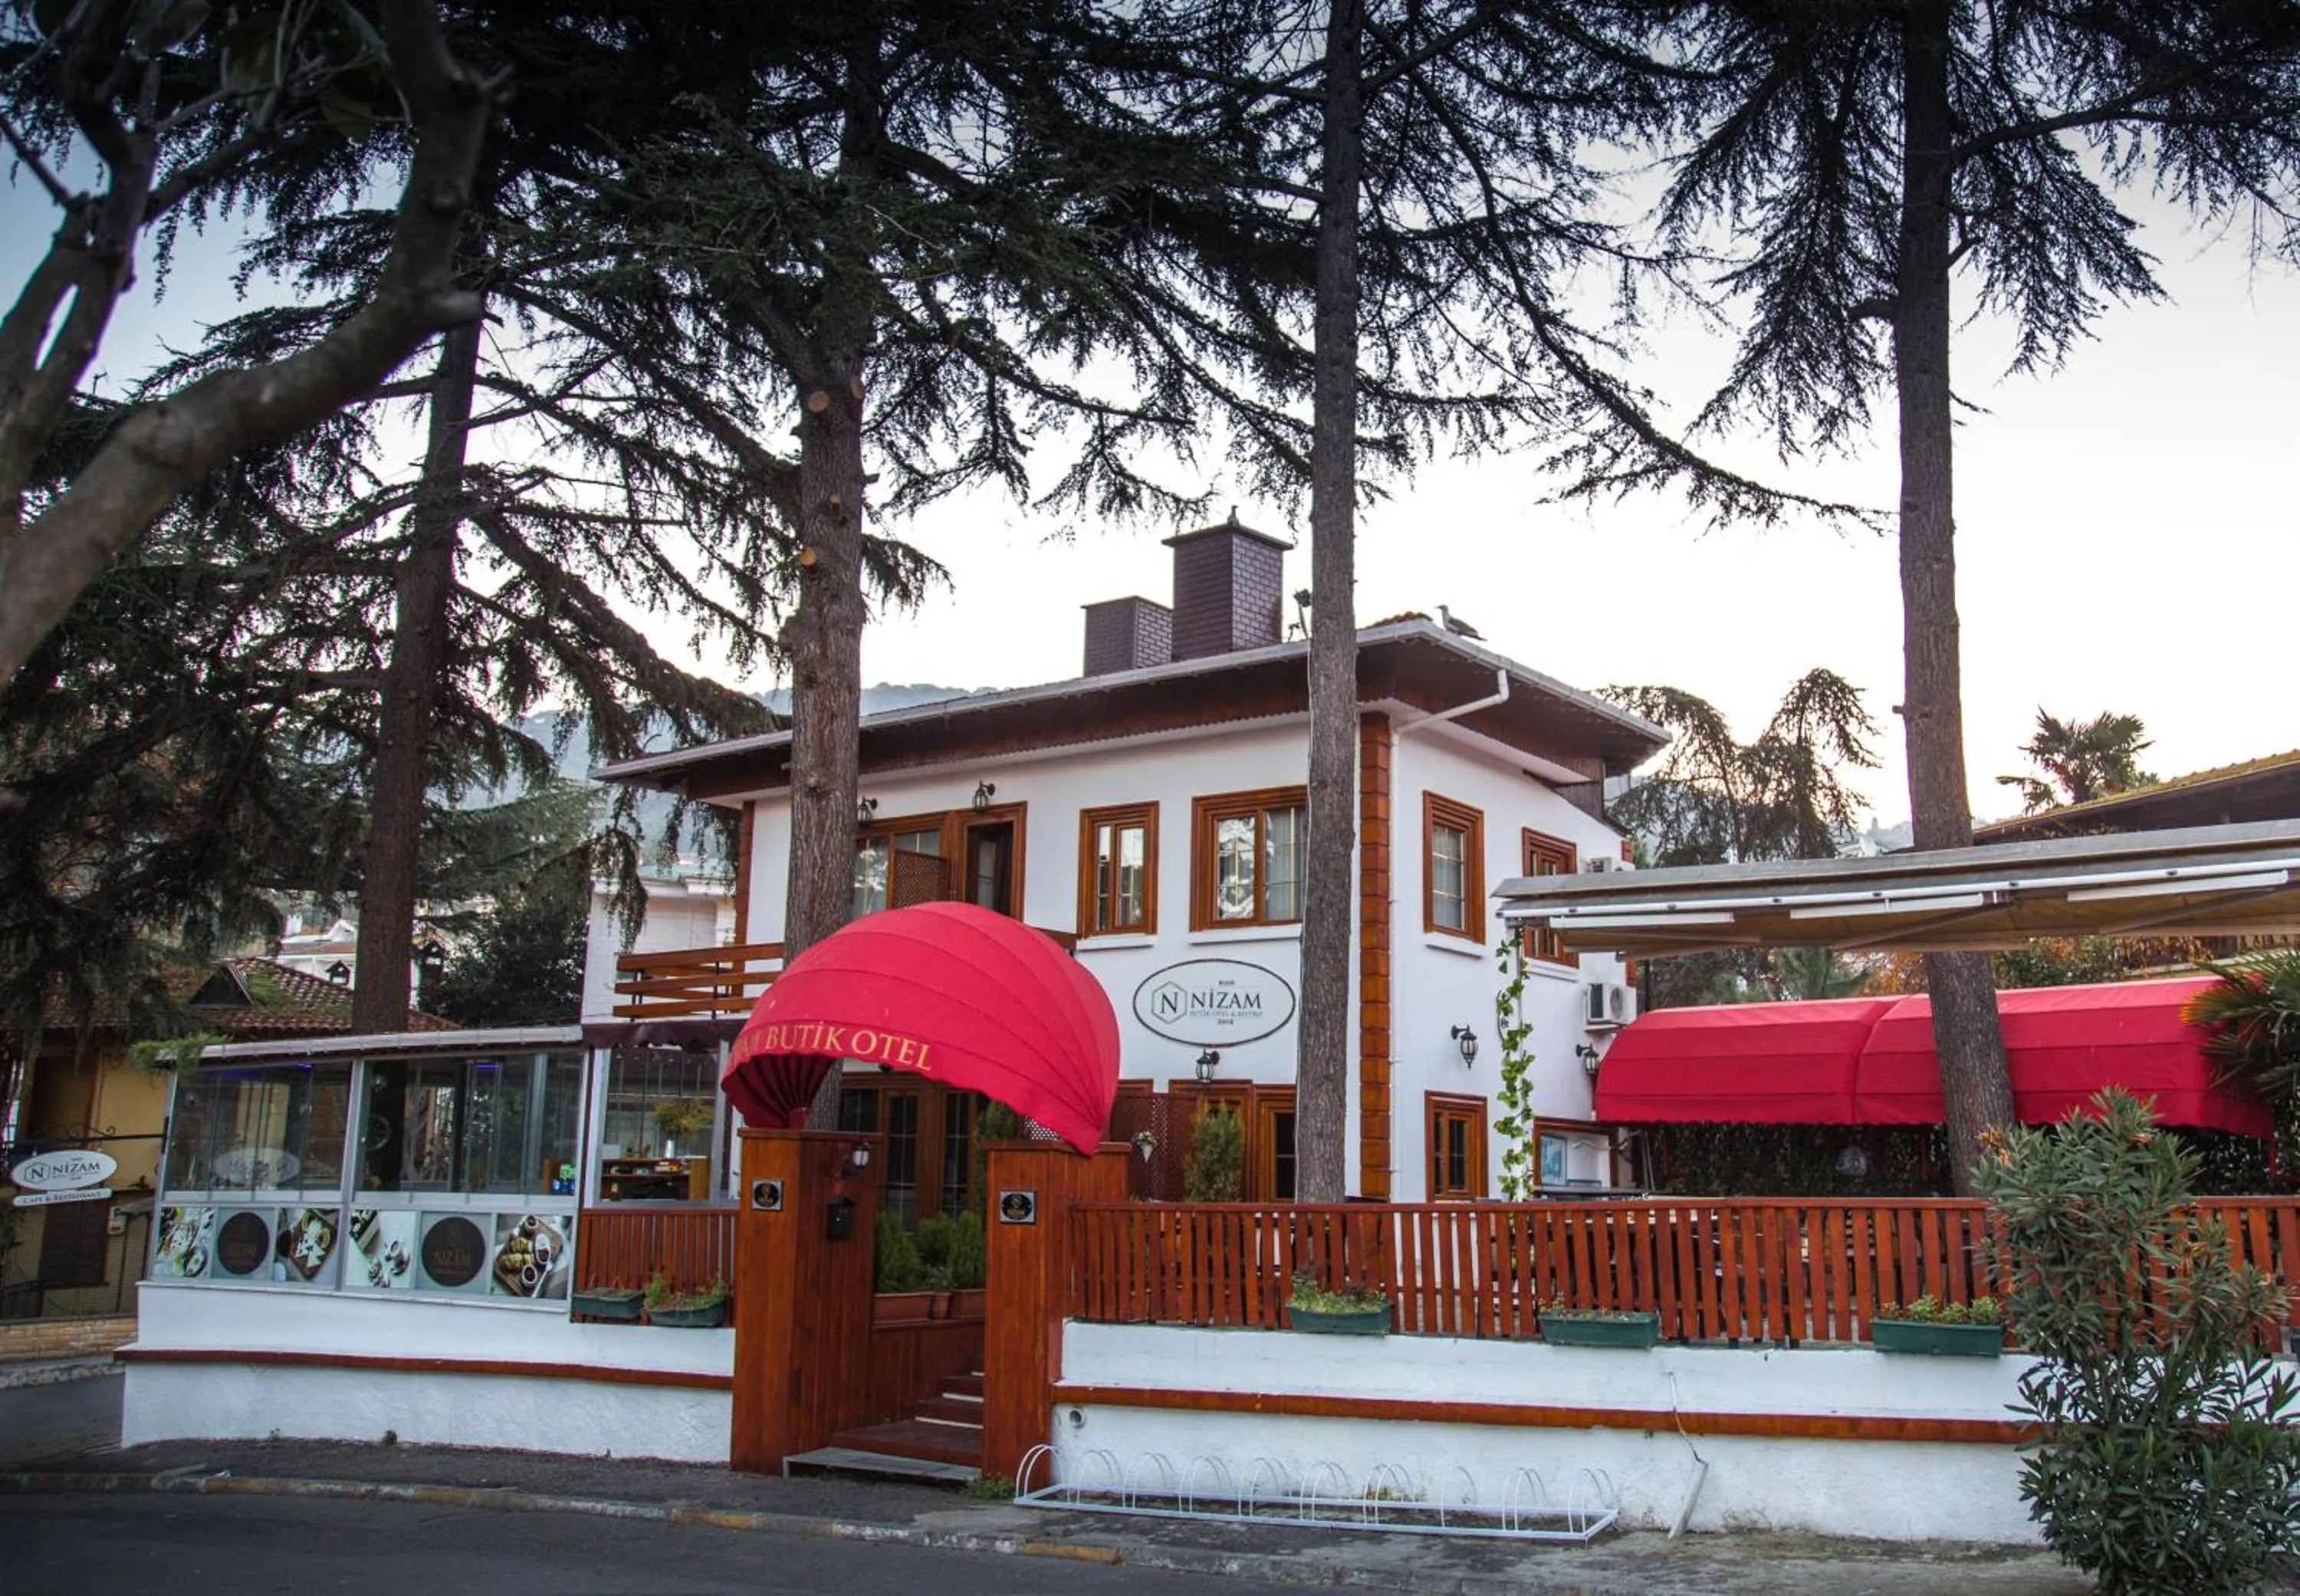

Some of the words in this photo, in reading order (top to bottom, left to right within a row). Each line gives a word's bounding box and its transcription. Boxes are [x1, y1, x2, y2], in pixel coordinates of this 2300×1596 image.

[1191, 988, 1261, 1009] NİZAM
[766, 1020, 846, 1051] BUTİK
[851, 1030, 932, 1070] OTEL
